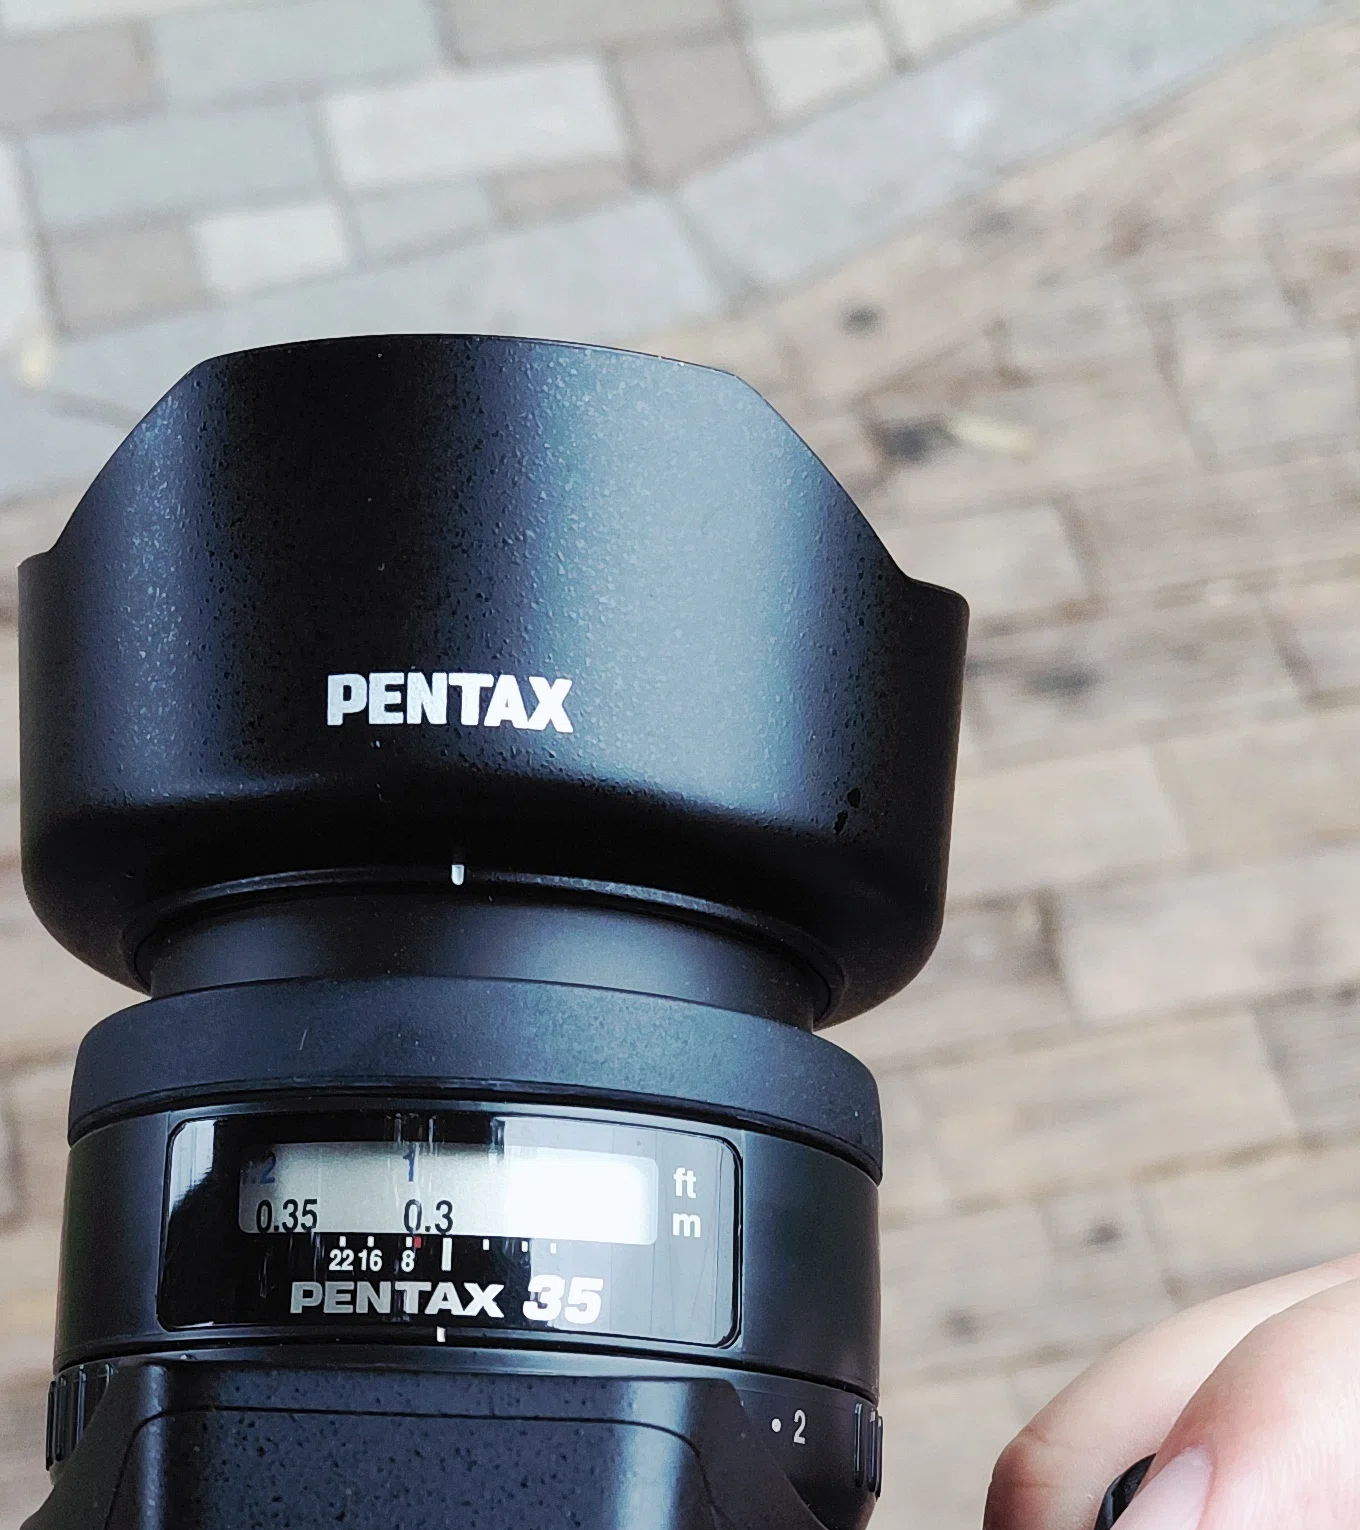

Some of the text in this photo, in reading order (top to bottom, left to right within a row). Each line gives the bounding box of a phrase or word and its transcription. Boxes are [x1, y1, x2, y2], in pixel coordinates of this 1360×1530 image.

[326, 671, 574, 733] PENTAX
[672, 1167, 697, 1198] ft
[255, 1198, 454, 1233] 0.35 0.3
[671, 1212, 702, 1238] m
[328, 1249, 415, 1272] 22 16 8
[290, 1274, 604, 1324] PENTAX 35
